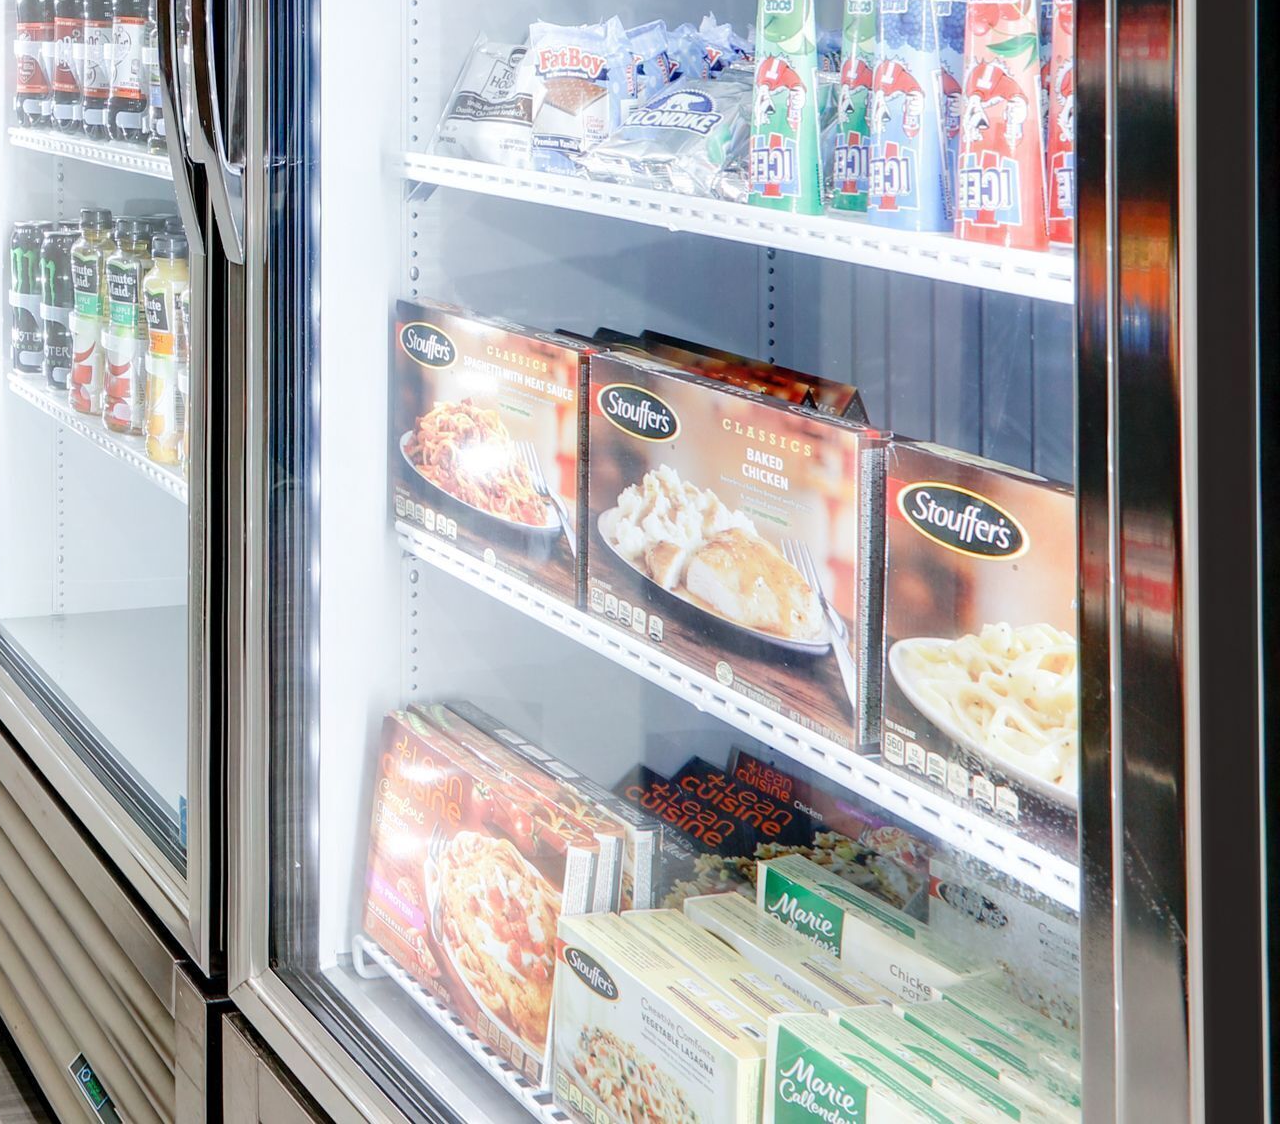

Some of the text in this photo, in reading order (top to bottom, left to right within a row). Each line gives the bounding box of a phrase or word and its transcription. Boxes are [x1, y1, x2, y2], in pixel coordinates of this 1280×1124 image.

[539, 46, 607, 80] FatBoy
[535, 136, 579, 152] Premium Vanilla
[959, 168, 1011, 210] ICEE
[405, 329, 453, 367] Stouffer's
[487, 344, 549, 374] CLASSICS
[463, 355, 574, 403] SPAGHETTI WITH MEAT SAUCE
[605, 391, 672, 436] Stouffer's
[721, 417, 814, 458] CLASSICS
[741, 462, 790, 492] CHICKEN
[745, 447, 784, 473] BAKED
[912, 490, 1012, 551] Stouffer's
[885, 736, 904, 753] 560
[736, 767, 790, 804] cuisine
[757, 763, 795, 792] Lean
[377, 777, 425, 826] Comfort
[624, 784, 723, 849] cuisine
[659, 788, 736, 838] Lean
[681, 774, 782, 838] cuisine
[726, 781, 794, 828] Lean
[793, 798, 824, 823] Chicken
[773, 890, 838, 938] Marie
[569, 951, 615, 1000] Stouffer's
[889, 962, 932, 998] Chicke
[641, 996, 718, 1064] Creative Comforts
[641, 1013, 716, 1077] VEGETABLE LASAGNA
[781, 1054, 860, 1116] Marie
